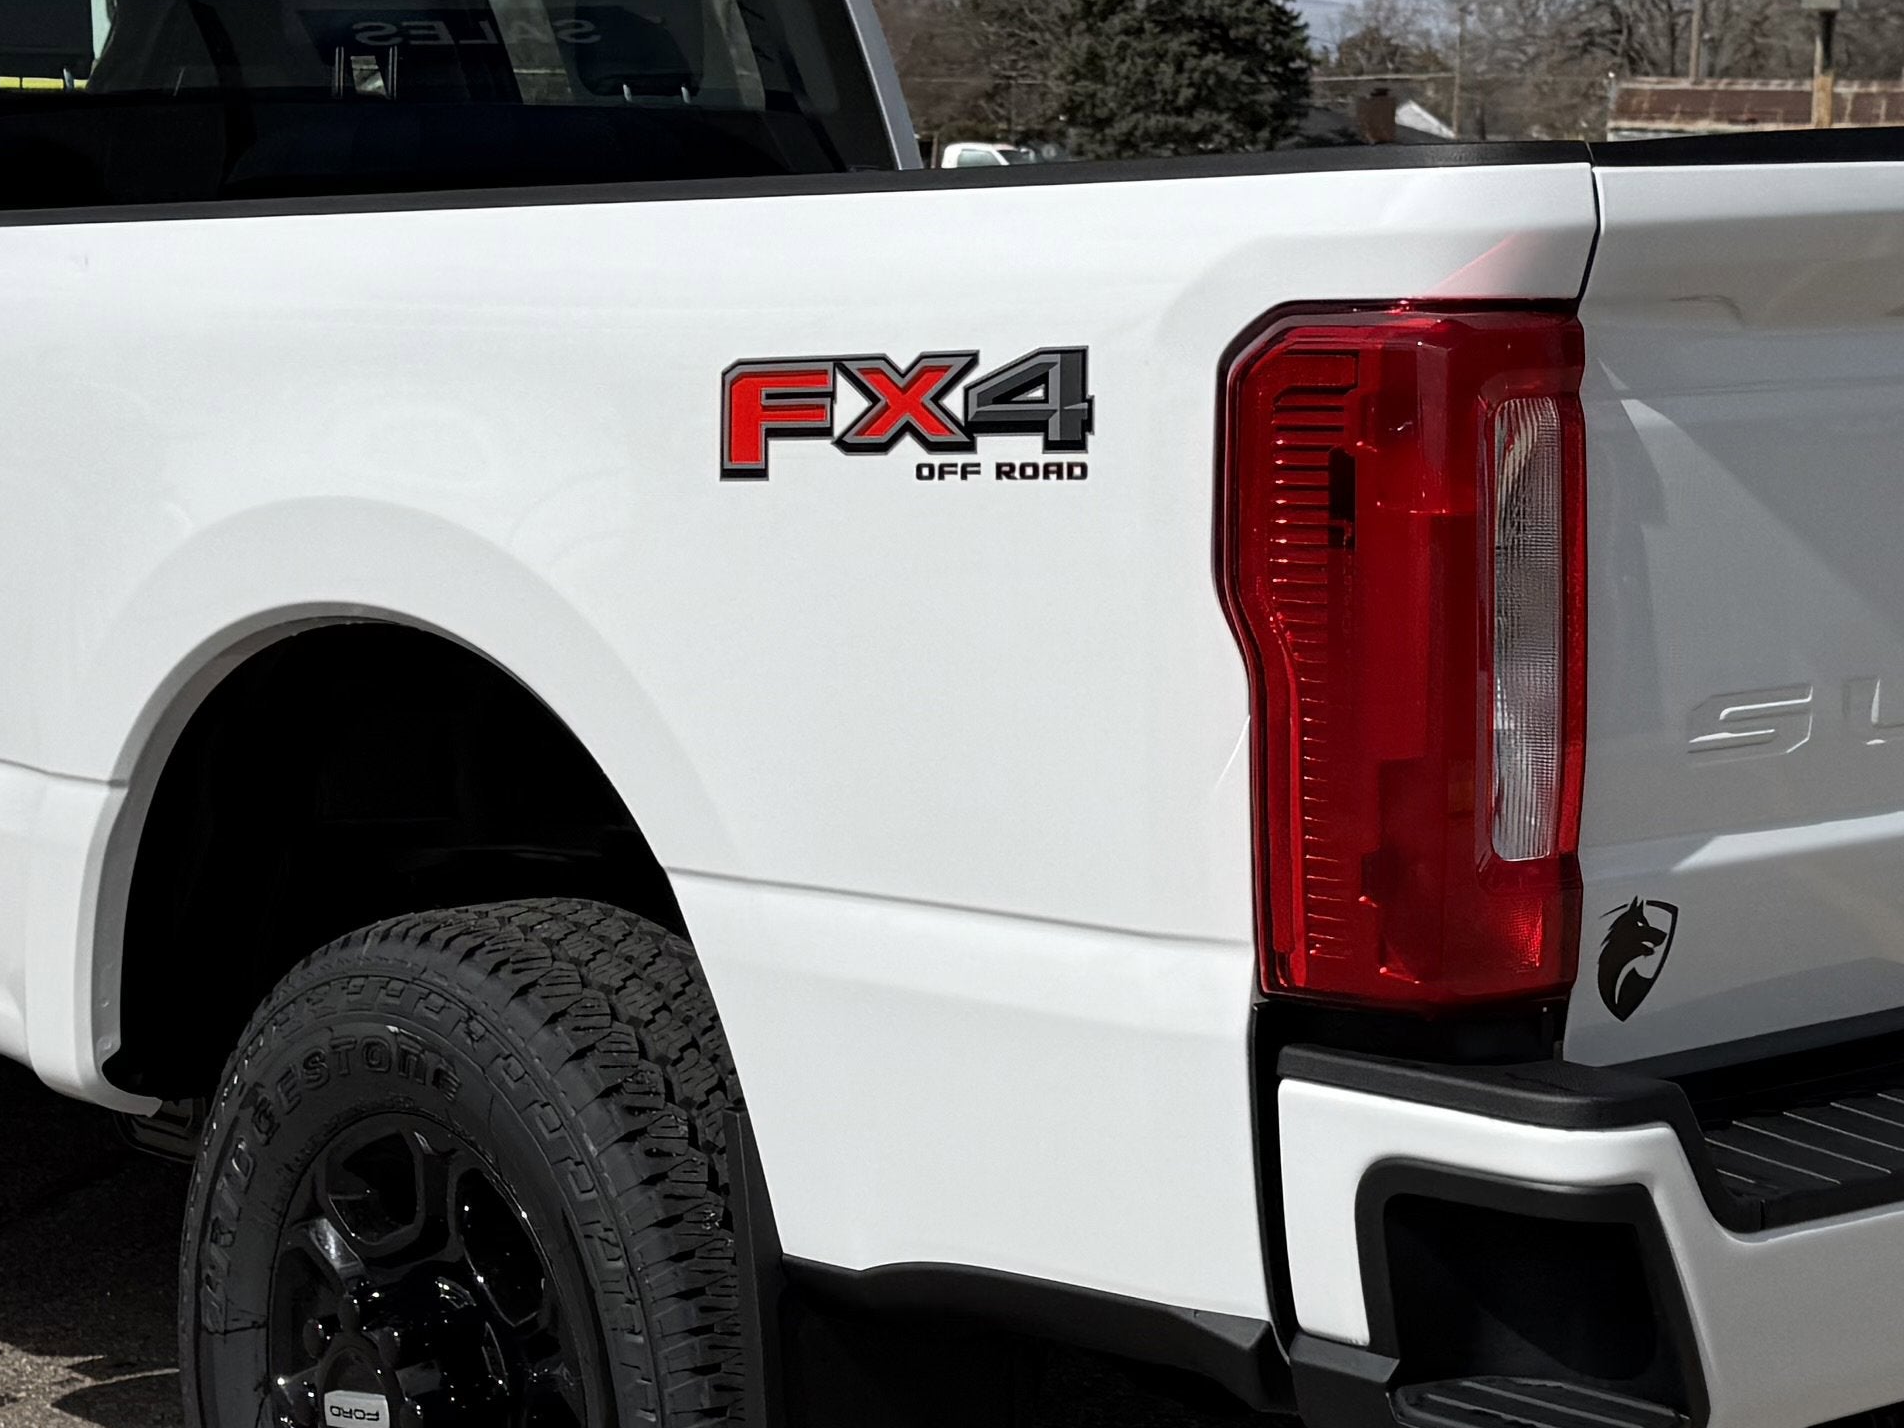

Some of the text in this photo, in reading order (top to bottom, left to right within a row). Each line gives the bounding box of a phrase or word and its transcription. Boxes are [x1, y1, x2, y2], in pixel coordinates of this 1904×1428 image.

[720, 346, 1094, 481] FX4
[915, 462, 1089, 481] OFF ROAD
[330, 1406, 380, 1422] FORD
